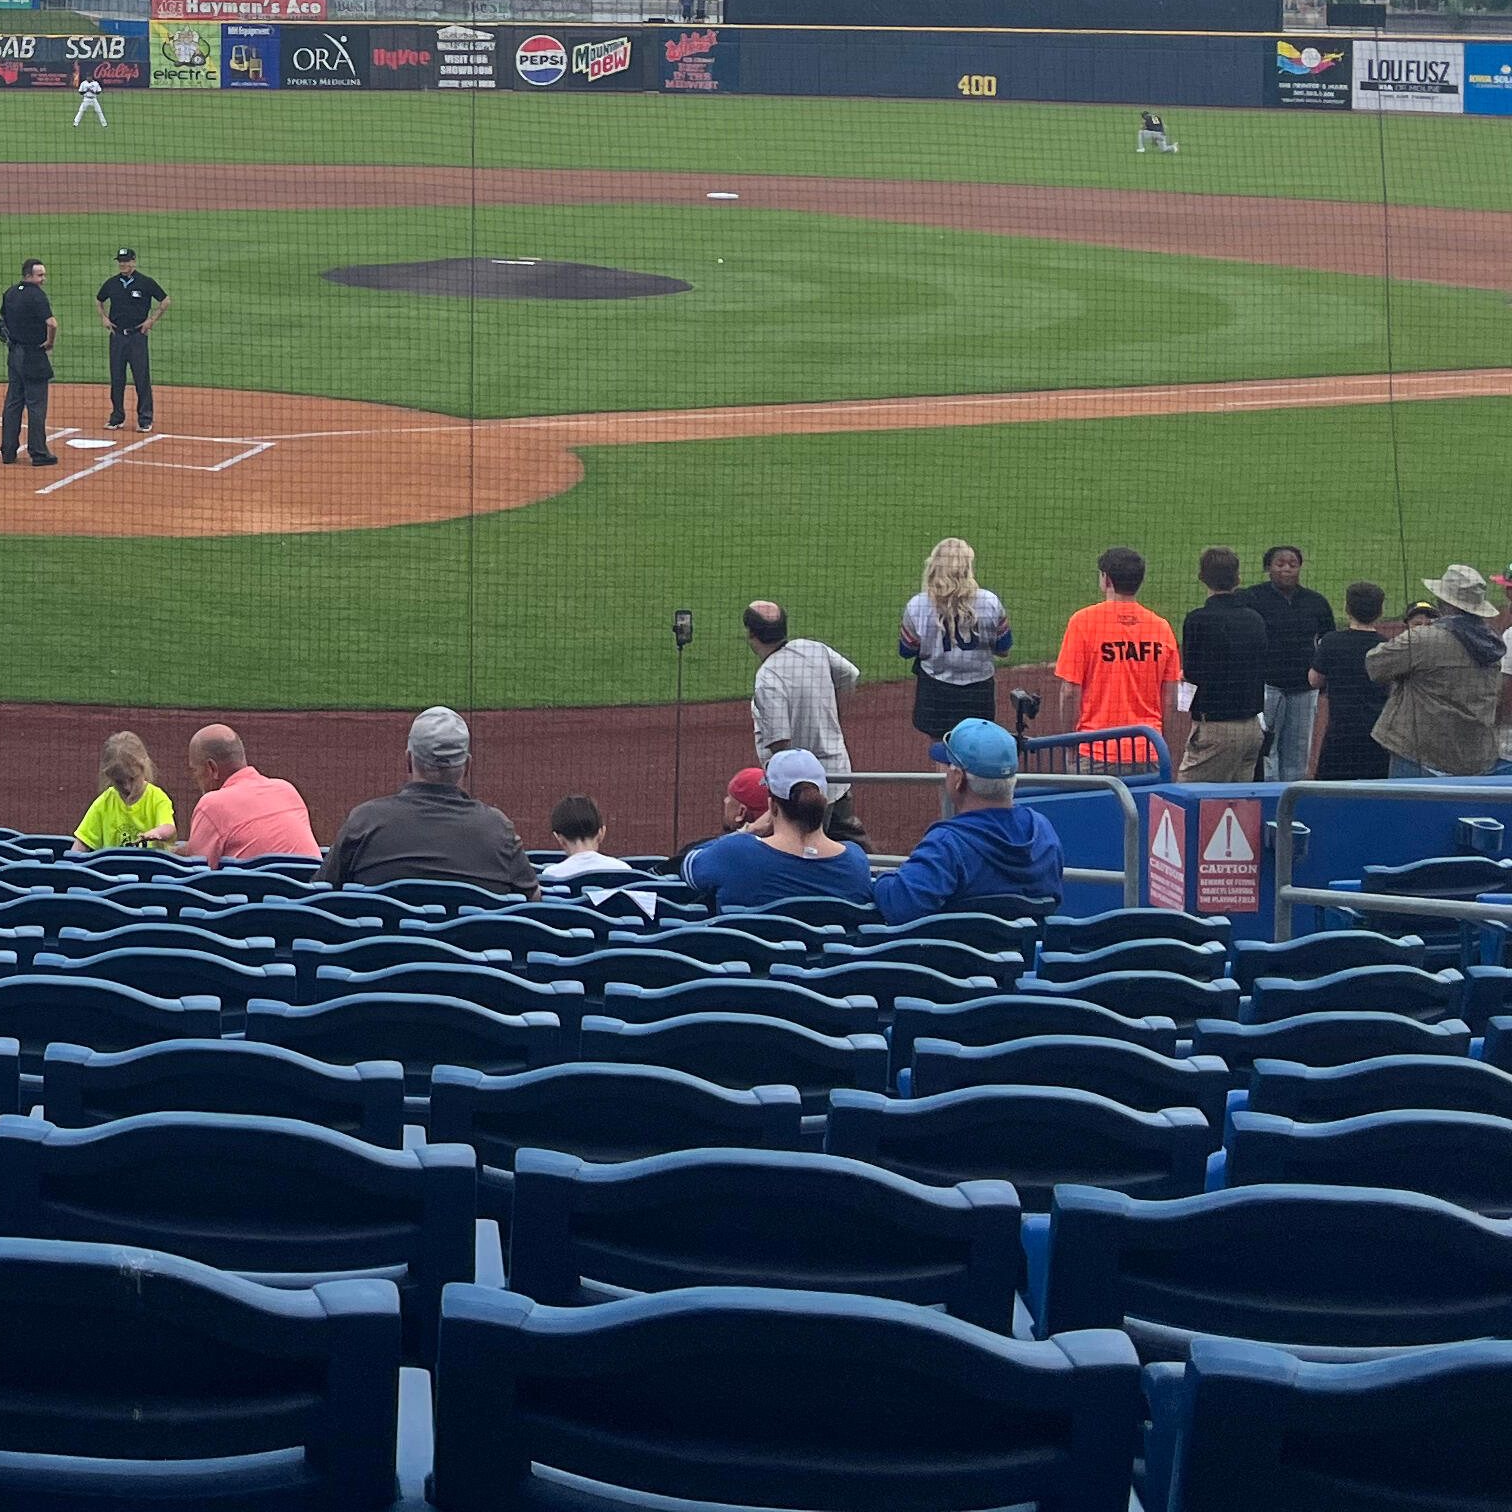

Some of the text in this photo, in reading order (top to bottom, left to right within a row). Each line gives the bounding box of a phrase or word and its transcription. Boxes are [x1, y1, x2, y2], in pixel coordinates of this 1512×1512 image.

[65, 36, 126, 59] SSAB
[292, 34, 356, 77] ORA
[444, 54, 468, 64] VISIT
[519, 54, 564, 66] PEPSI
[440, 65, 493, 75] SHOWROOM
[1367, 58, 1402, 82] LOU
[1405, 59, 1451, 84] FUSZ
[286, 77, 361, 86] SPORTS MEDICINE
[957, 74, 997, 97] 400
[1100, 641, 1163, 663] STAFF
[1199, 864, 1258, 874] CAUTION
[1200, 896, 1211, 904] THE
